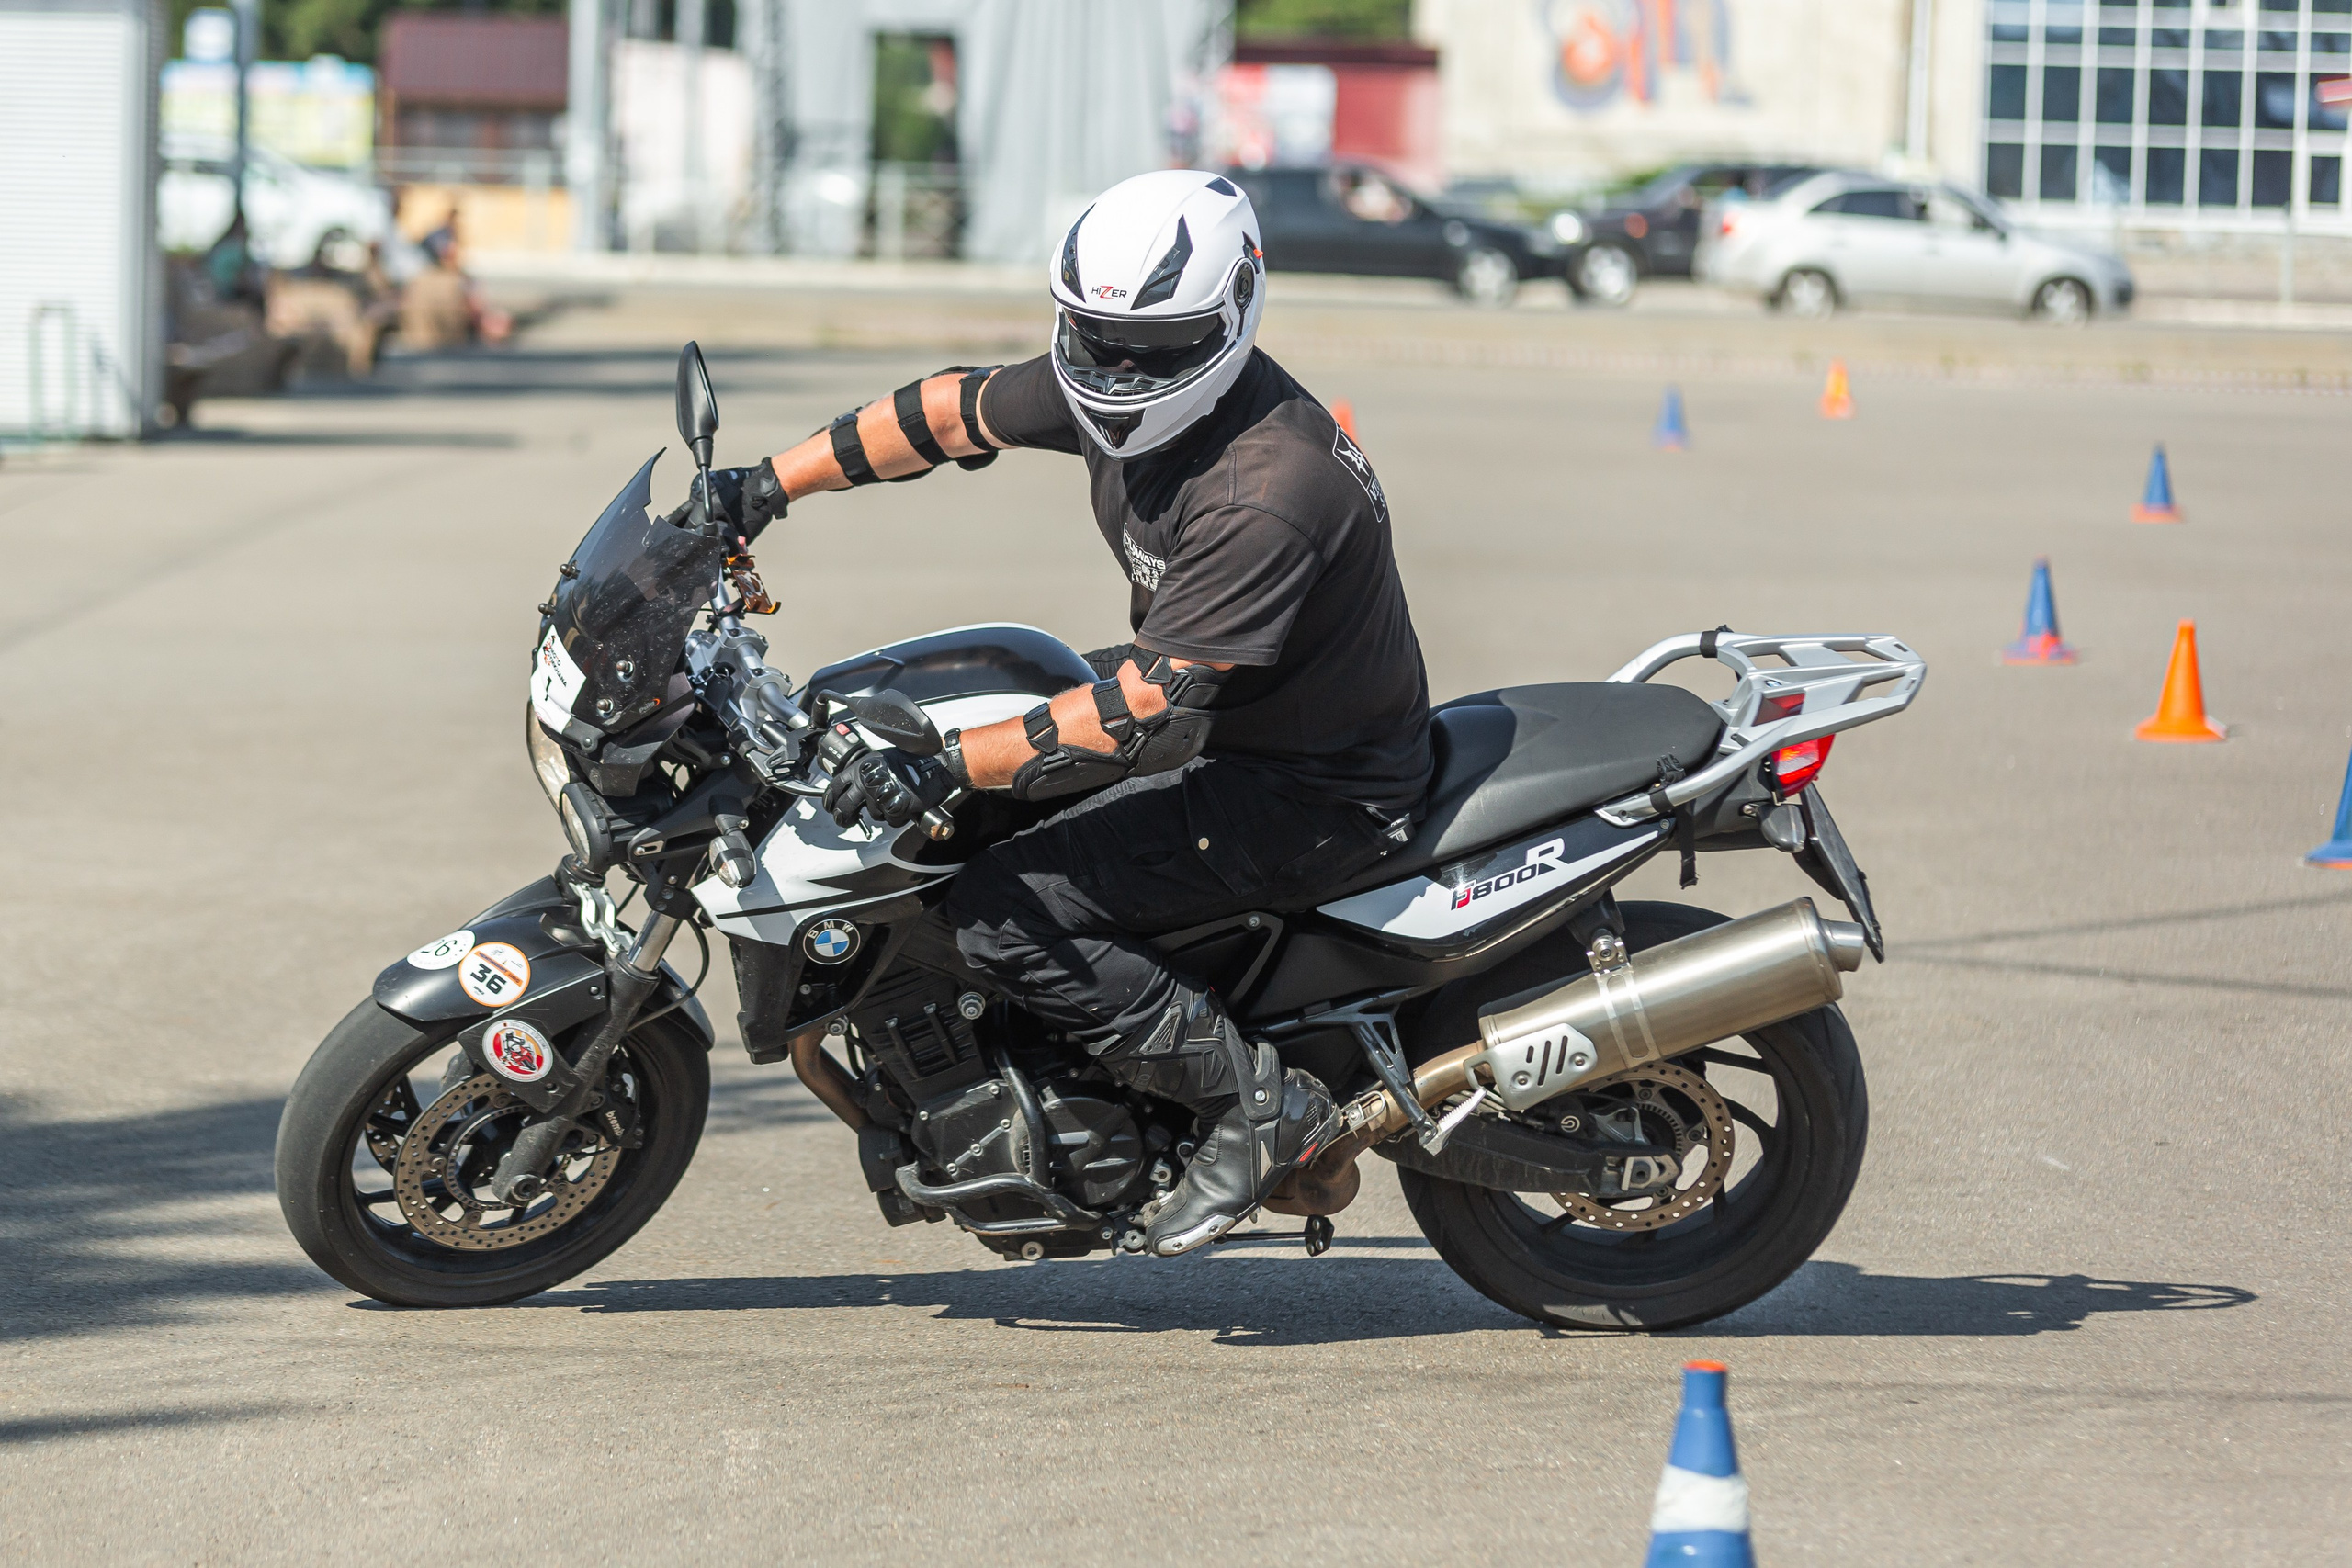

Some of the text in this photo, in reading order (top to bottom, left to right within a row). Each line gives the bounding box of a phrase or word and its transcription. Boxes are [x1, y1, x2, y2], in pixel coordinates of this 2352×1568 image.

[1091, 286, 1127, 299] HIZER
[808, 920, 854, 940] BMW
[470, 963, 507, 995] 36
